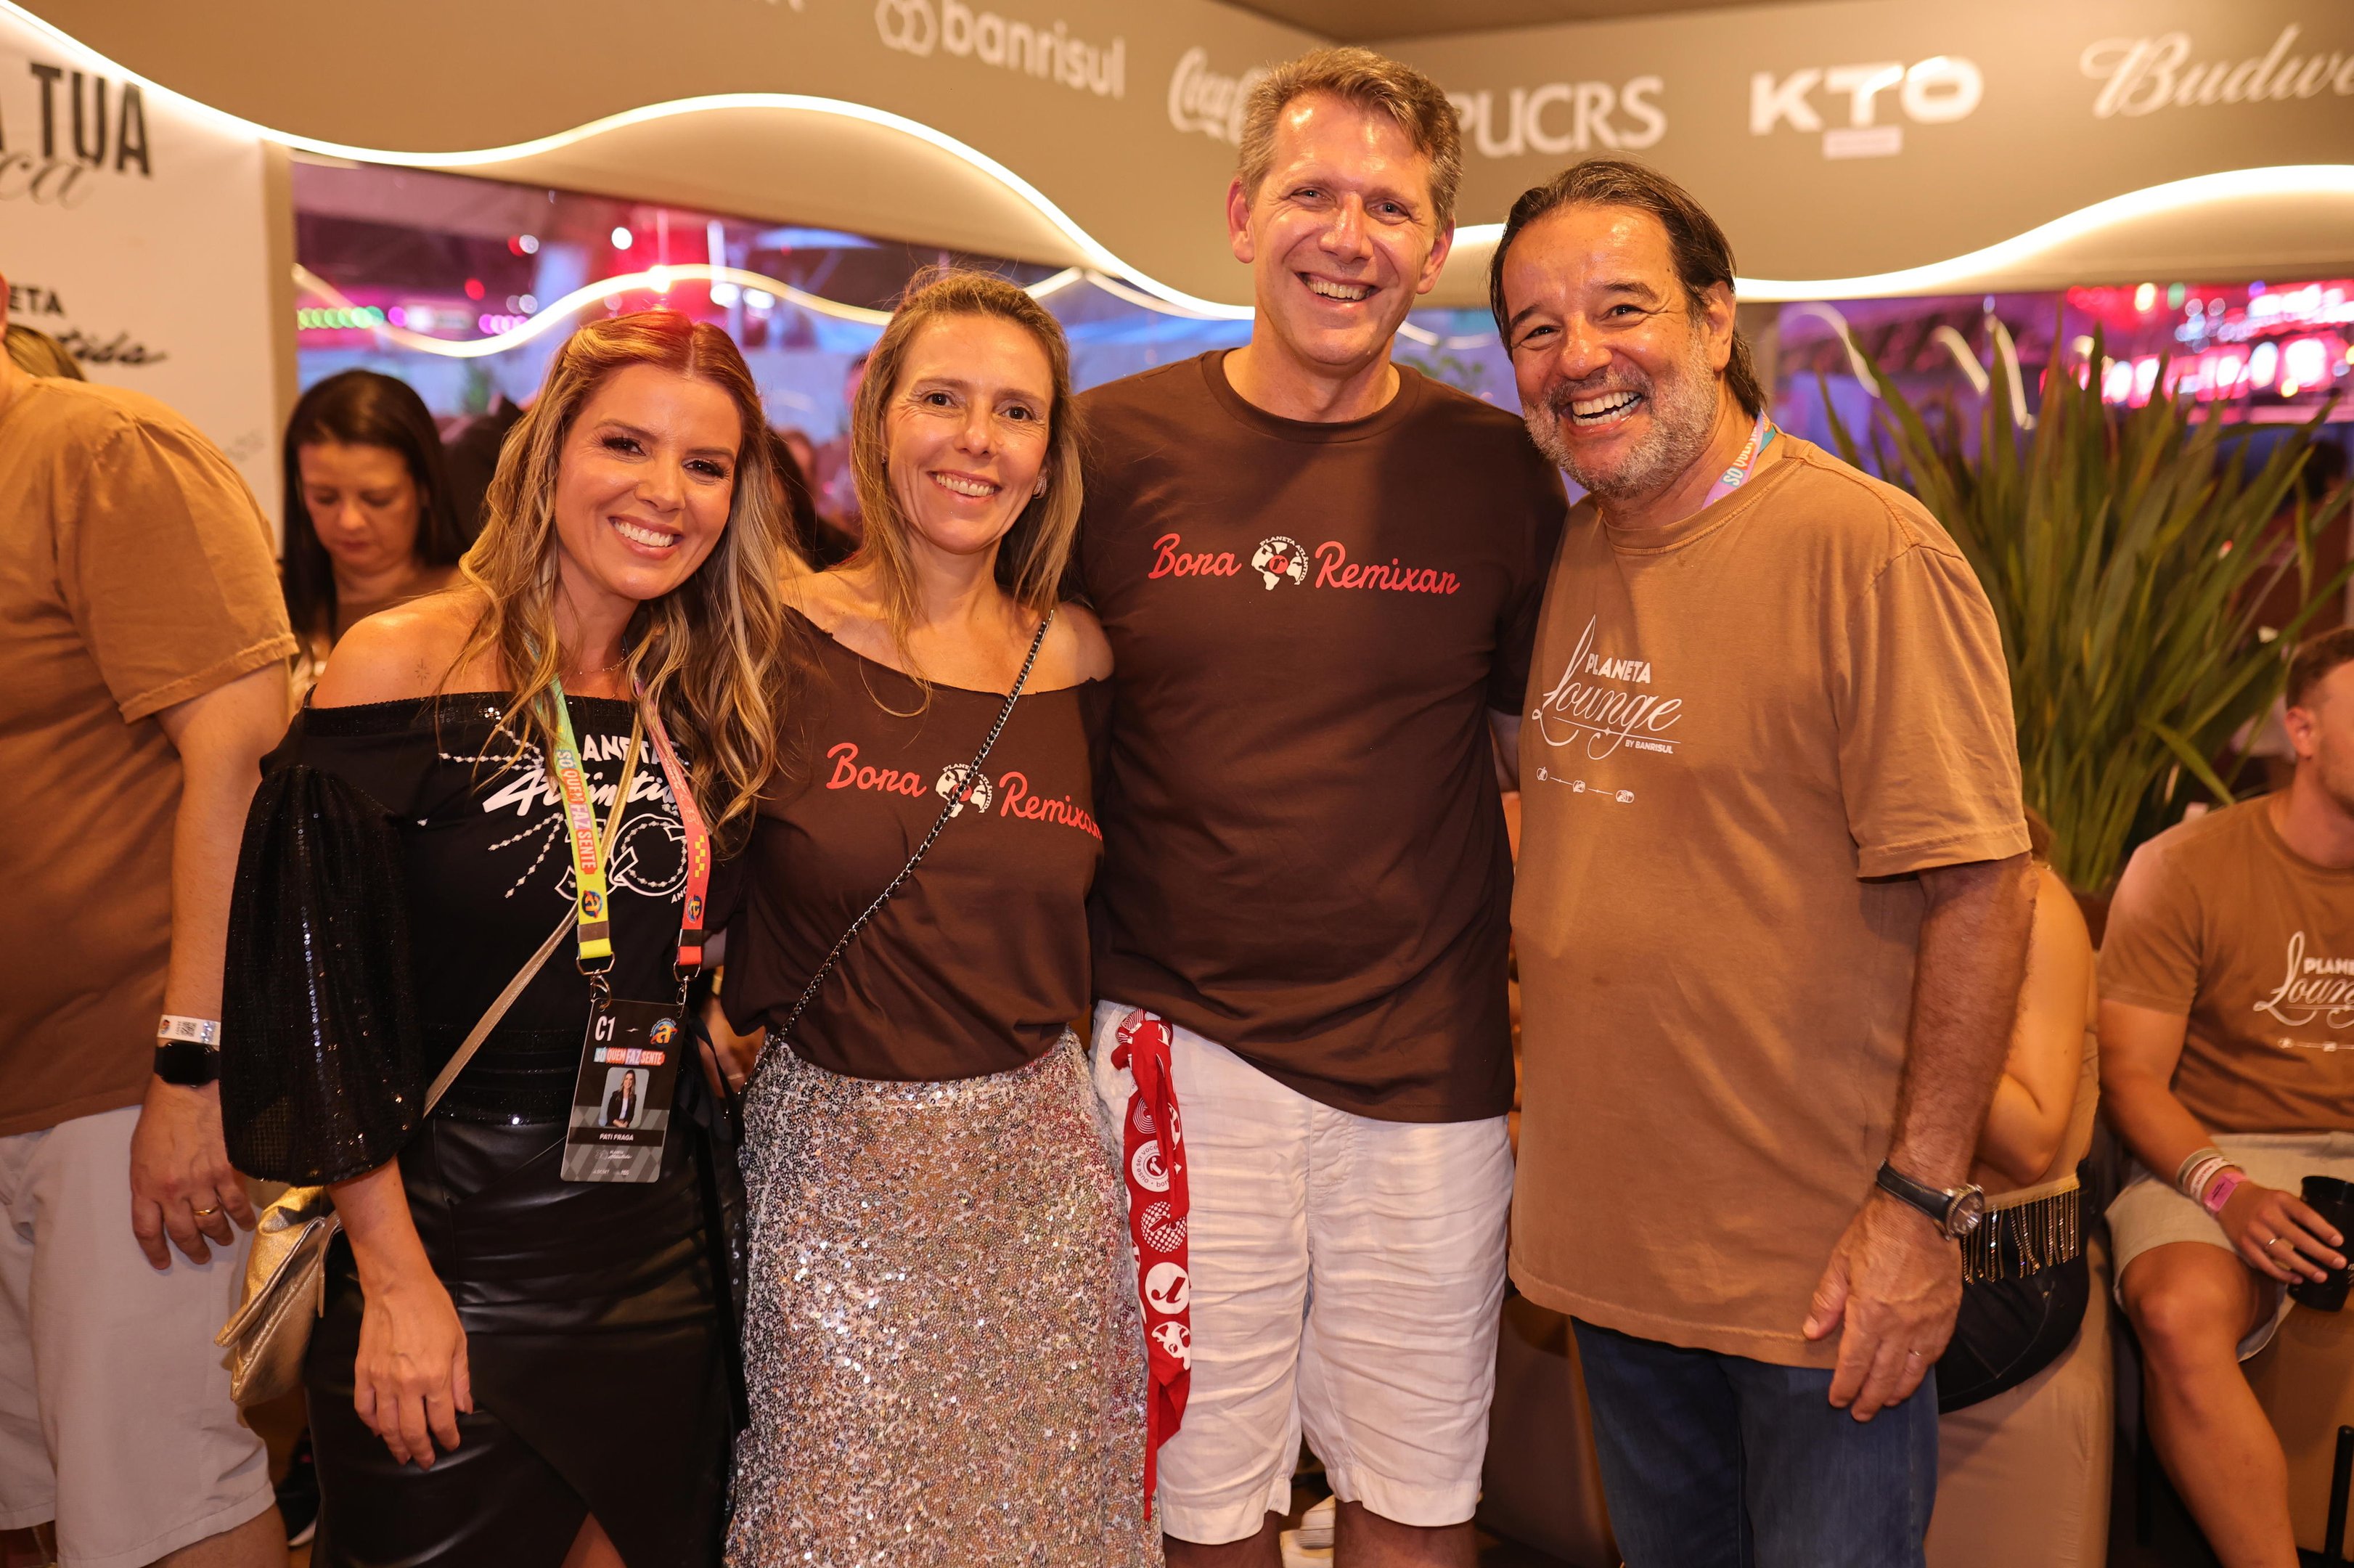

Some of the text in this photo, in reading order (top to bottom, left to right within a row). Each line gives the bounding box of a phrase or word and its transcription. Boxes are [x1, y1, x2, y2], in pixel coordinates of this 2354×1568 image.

[941, 0, 1124, 99] banrisul
[1749, 55, 1985, 136] KTO
[30, 62, 151, 176] TUA
[1259, 536, 1295, 547] PLANETA
[1585, 653, 1651, 684] PLANETA
[1532, 614, 1682, 760] Lounge
[1625, 740, 1674, 754] BY BANRISUL
[569, 804, 592, 829] FAZ
[578, 831, 597, 869] SENTE
[595, 1016, 616, 1041] C1
[607, 1048, 626, 1063] QUEM
[625, 1048, 642, 1065] FAZ
[640, 1051, 663, 1065] SENTE
